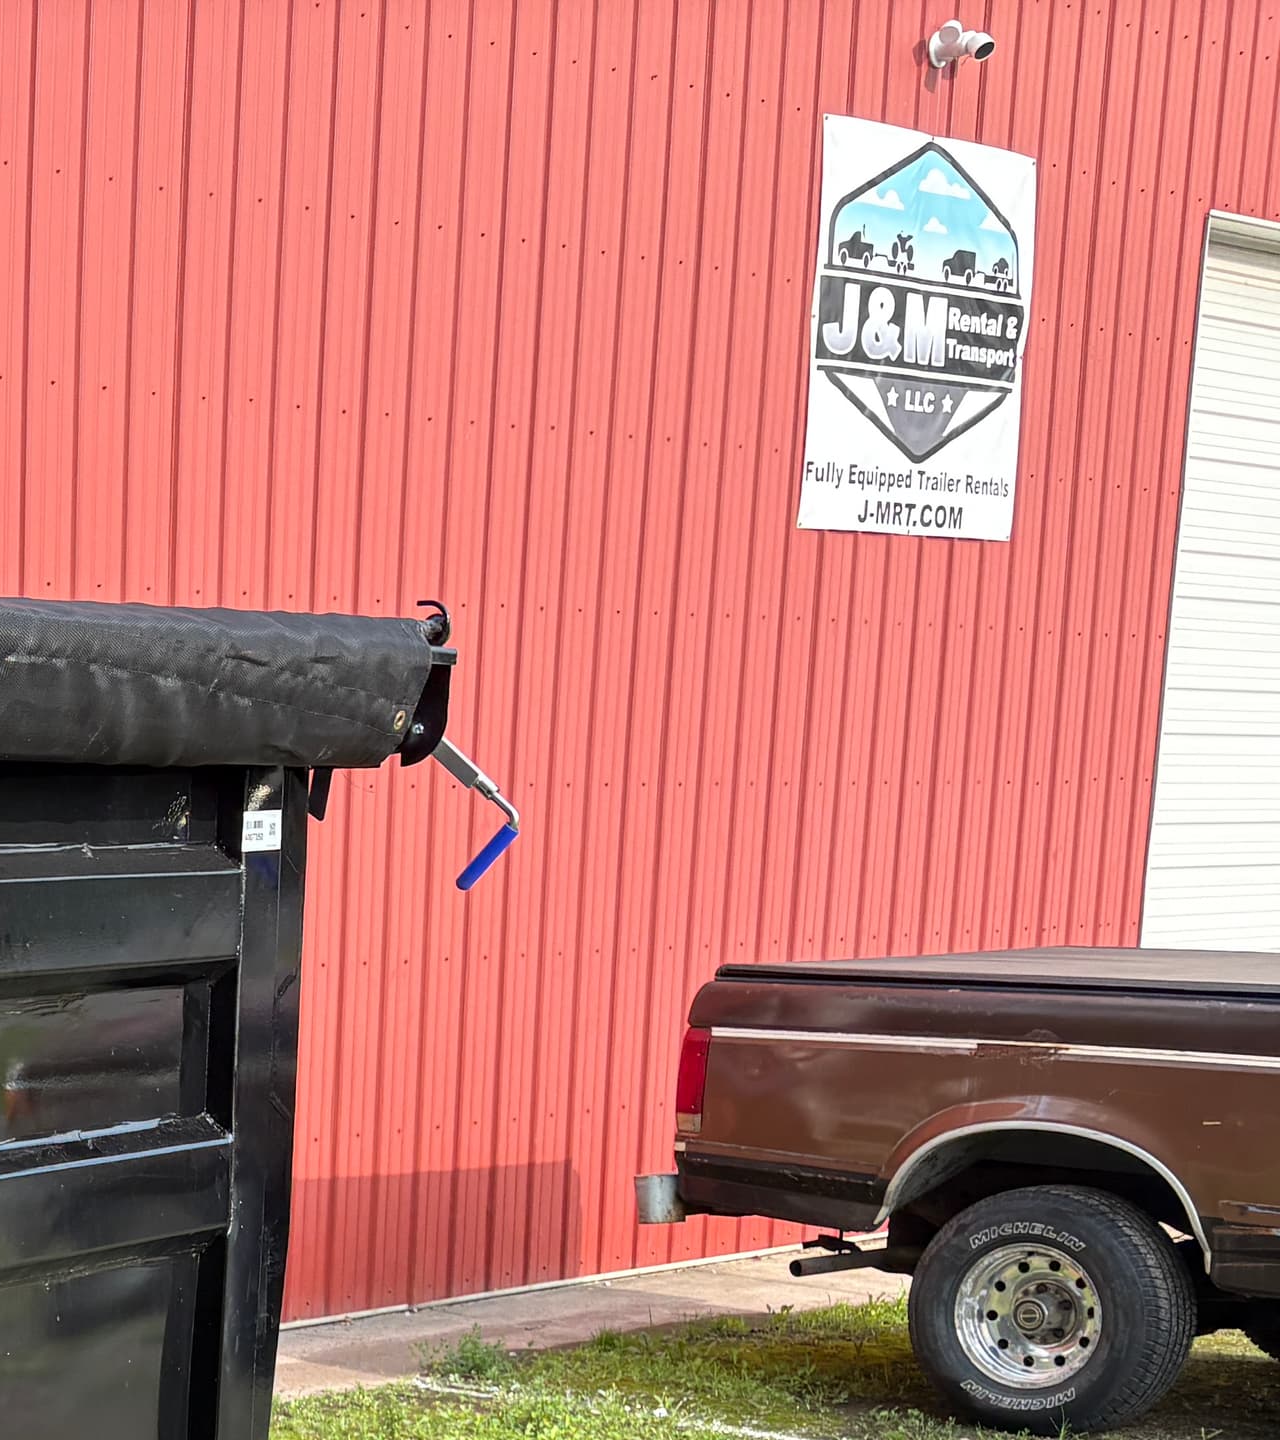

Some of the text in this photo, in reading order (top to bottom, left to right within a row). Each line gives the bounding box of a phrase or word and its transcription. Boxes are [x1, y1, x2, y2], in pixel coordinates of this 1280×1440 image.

[822, 282, 948, 367] J&M
[949, 306, 1019, 340] Rental &
[946, 339, 1015, 368] Transport
[904, 390, 935, 414] LLC
[806, 461, 1009, 497] Fully Equipped Trailer Rentals
[858, 500, 963, 530] J-MRT.COM
[969, 1221, 1086, 1252] MICHELIN
[961, 1379, 1076, 1410] MICHELIN
